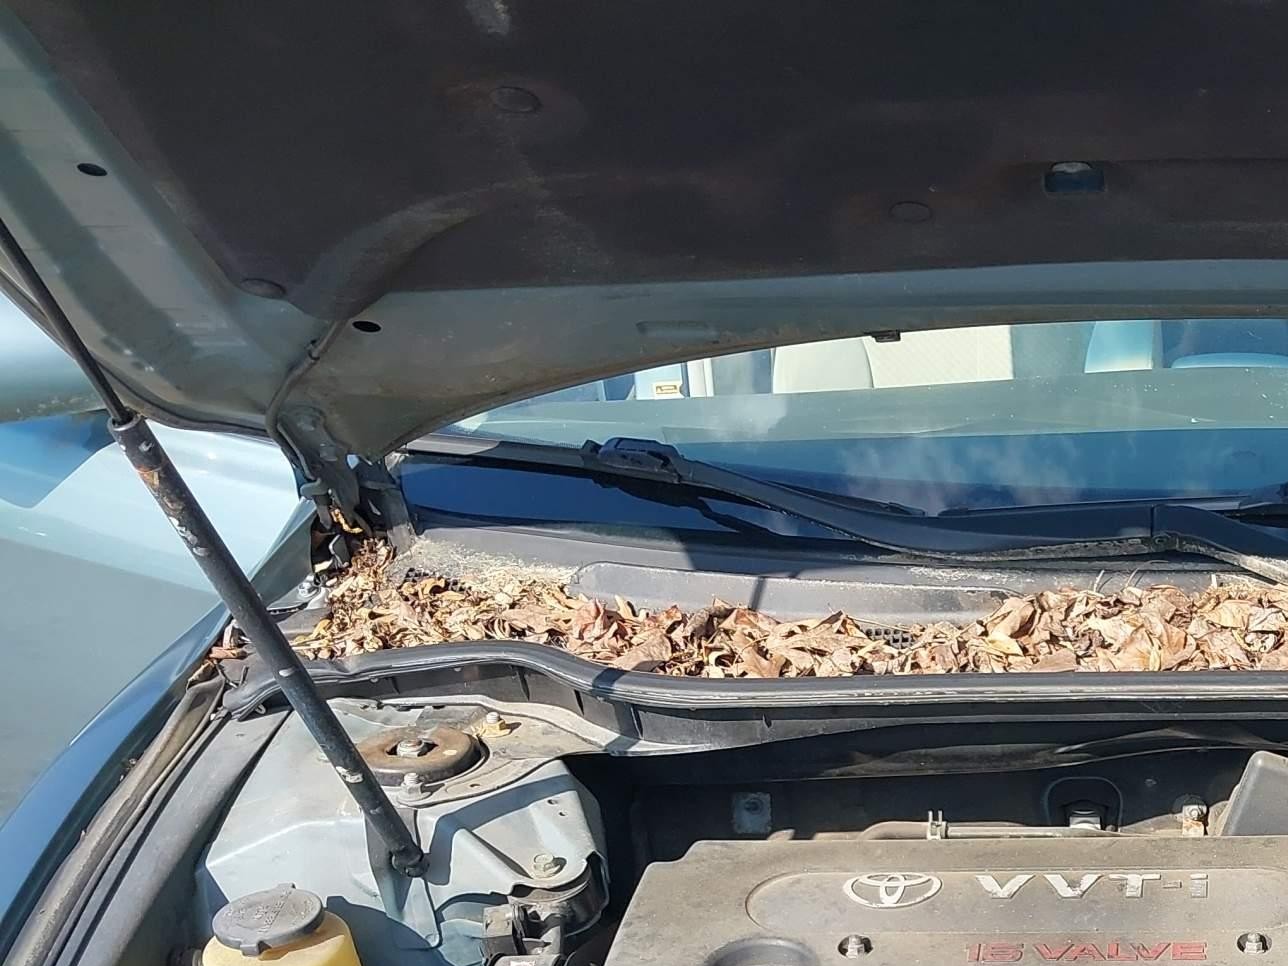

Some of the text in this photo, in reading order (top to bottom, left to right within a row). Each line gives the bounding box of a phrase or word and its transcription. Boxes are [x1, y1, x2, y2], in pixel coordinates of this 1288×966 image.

[975, 873, 1208, 899] VVT-i
[967, 942, 1208, 962] 16 VALVE
